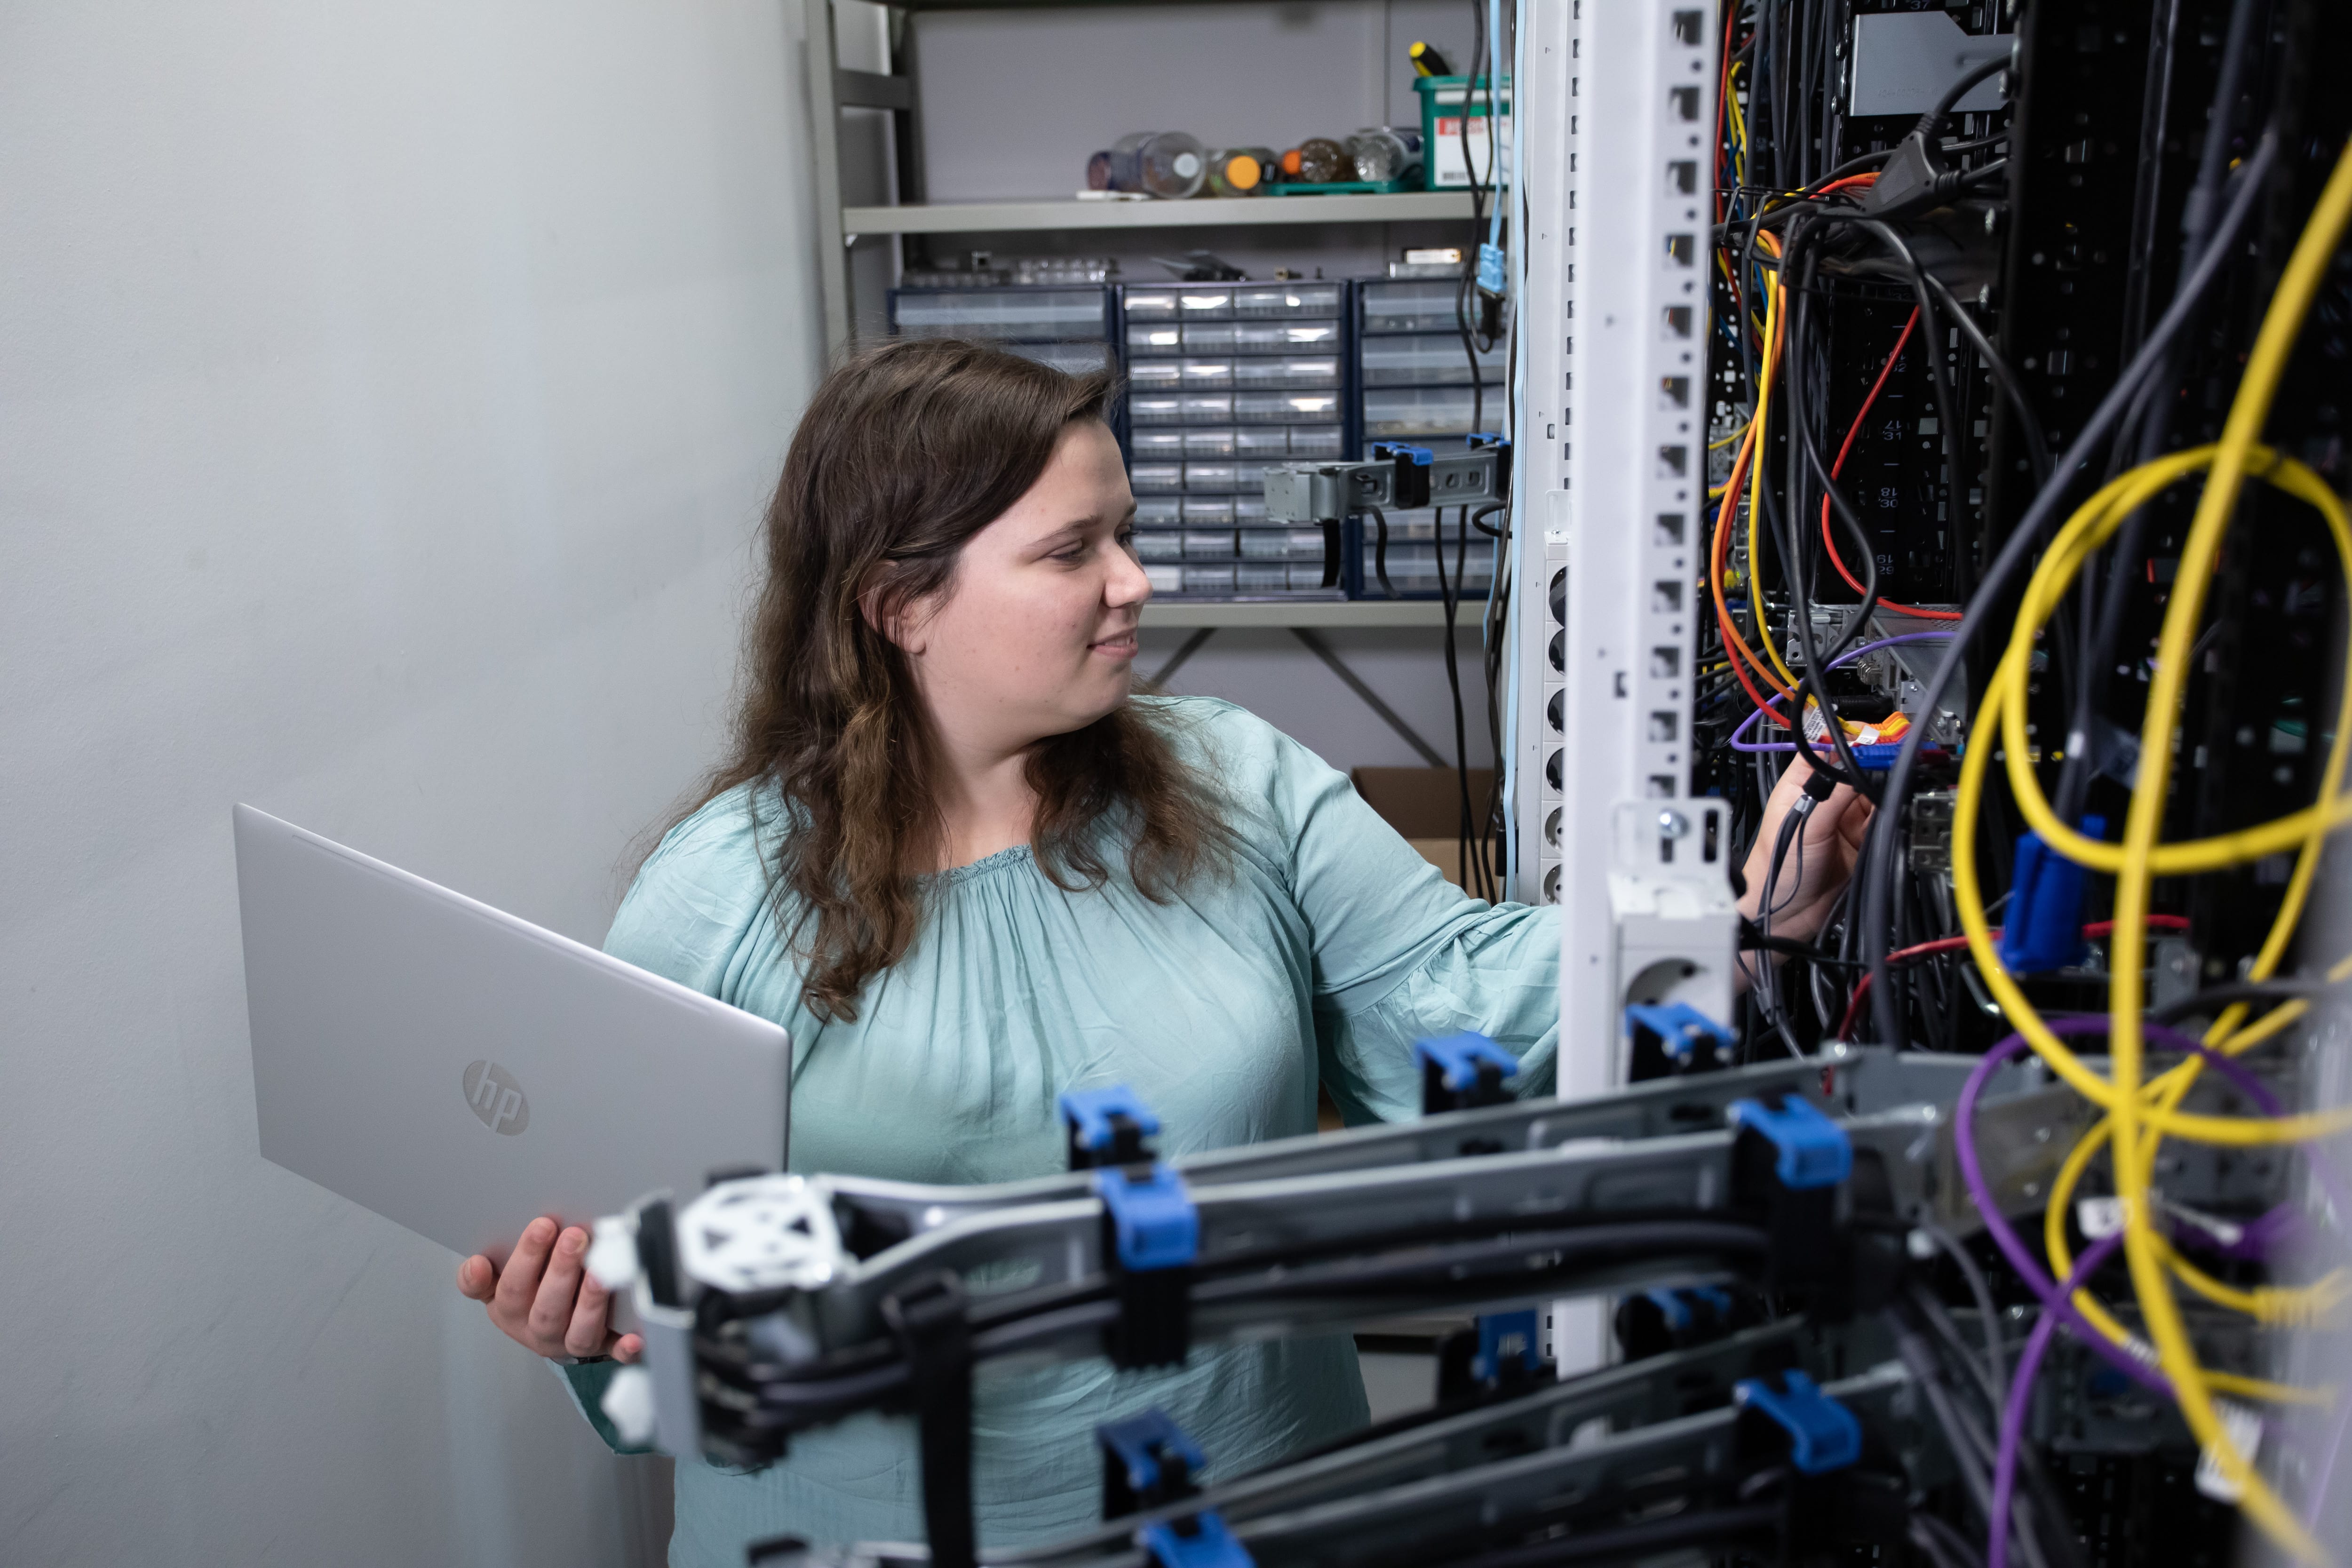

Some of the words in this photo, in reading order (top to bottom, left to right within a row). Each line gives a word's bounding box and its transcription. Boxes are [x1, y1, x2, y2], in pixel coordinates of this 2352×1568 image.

[1910, 0, 1930, 9] 37
[1884, 420, 1902, 429] 17
[1883, 432, 1901, 440] 31
[1881, 487, 1898, 496] 18
[1880, 499, 1898, 508] 30
[1877, 555, 1893, 563] 19
[1878, 566, 1894, 574] 29
[470, 1060, 524, 1134] hp
